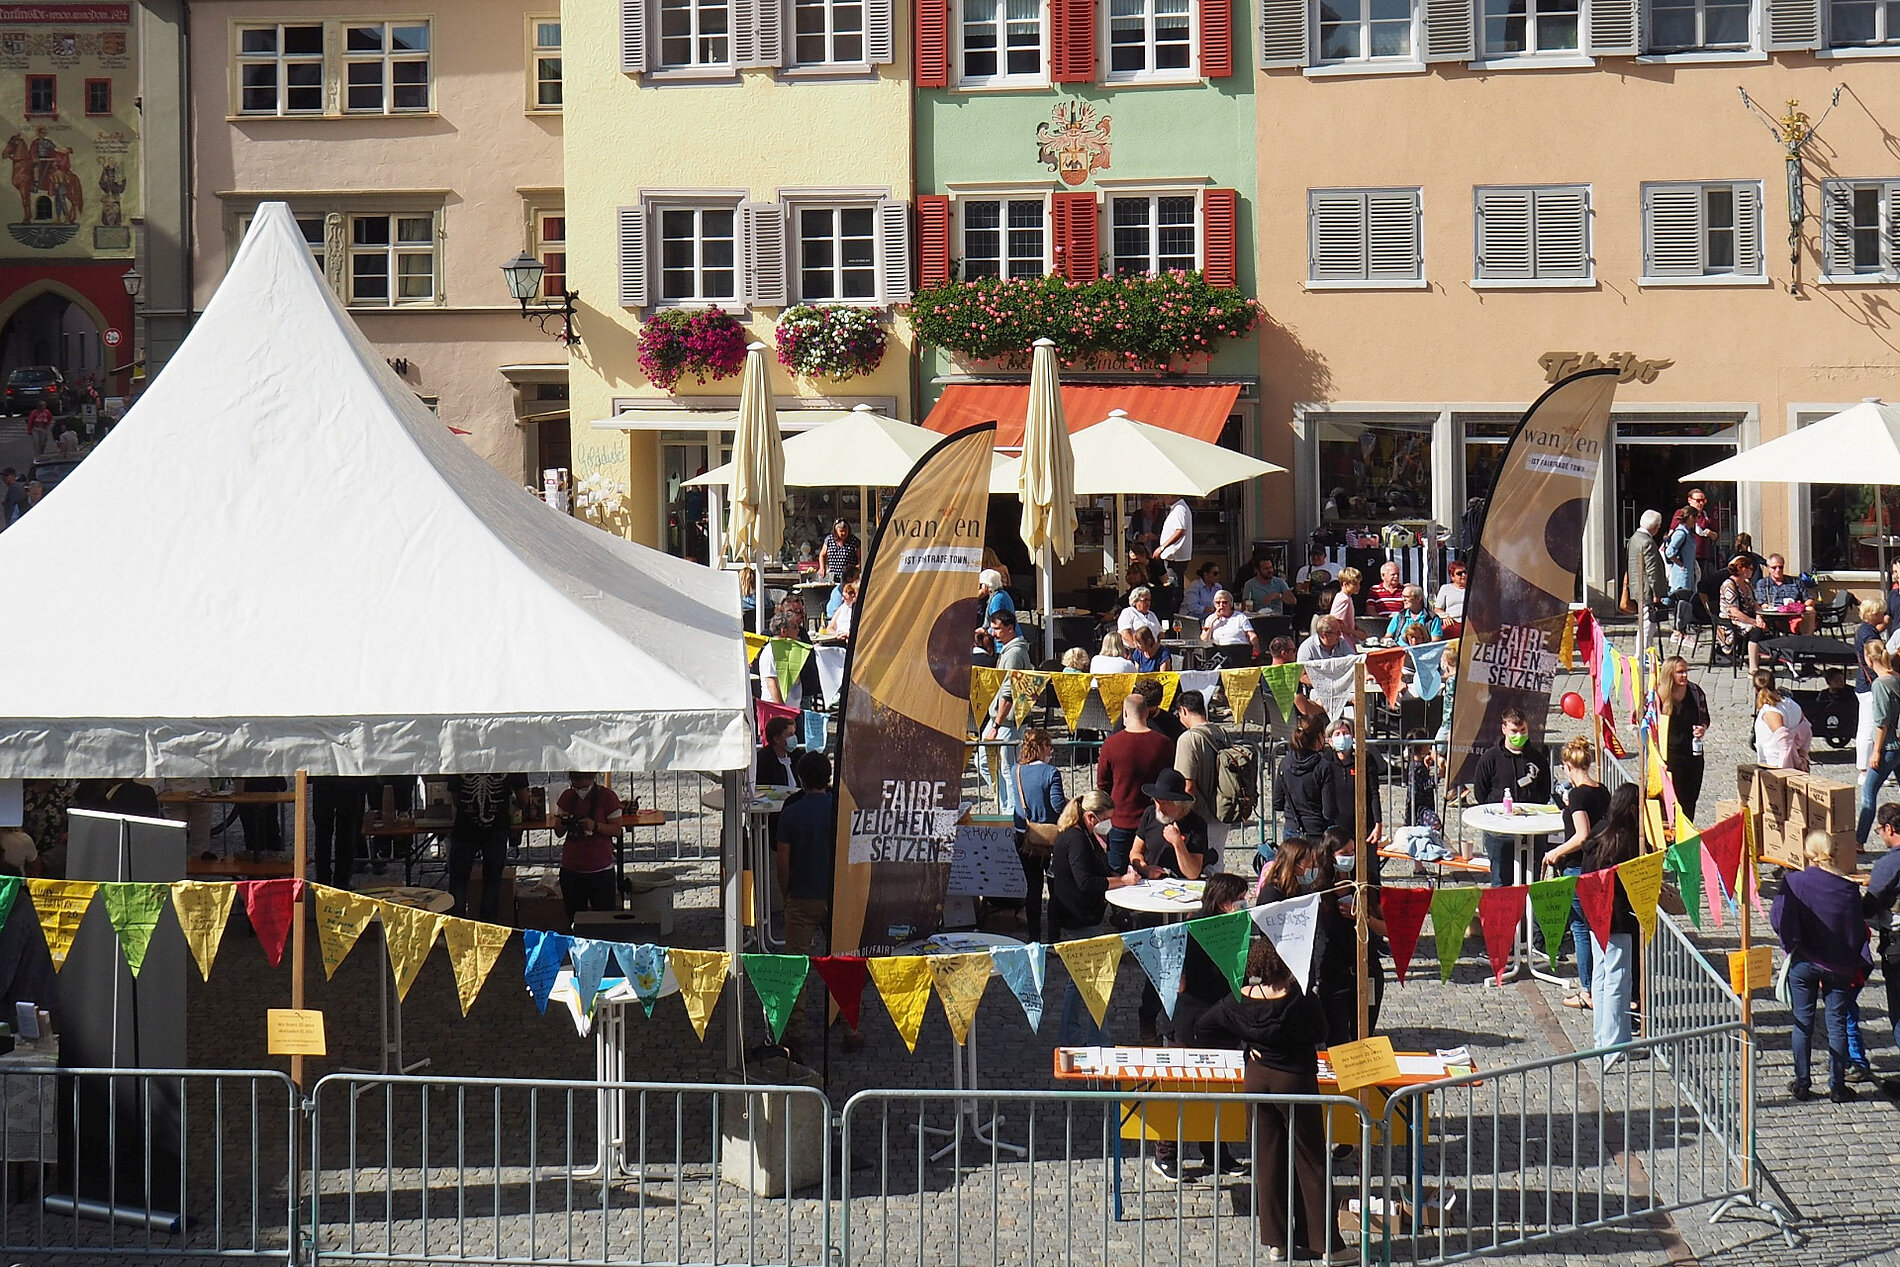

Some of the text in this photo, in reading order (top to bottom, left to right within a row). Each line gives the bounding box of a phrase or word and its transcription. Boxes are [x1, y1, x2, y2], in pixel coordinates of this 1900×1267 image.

[893, 518, 981, 538] wanen
[904, 556, 917, 565] IST
[918, 555, 947, 564] FTRADE
[1498, 623, 1551, 652] FAIRE
[1472, 642, 1541, 671] ZEICHEN
[1488, 665, 1544, 692] SETZEN
[880, 780, 946, 812] FAIRE
[852, 809, 935, 837] ZEICHEN
[869, 835, 941, 862] SETZEN
